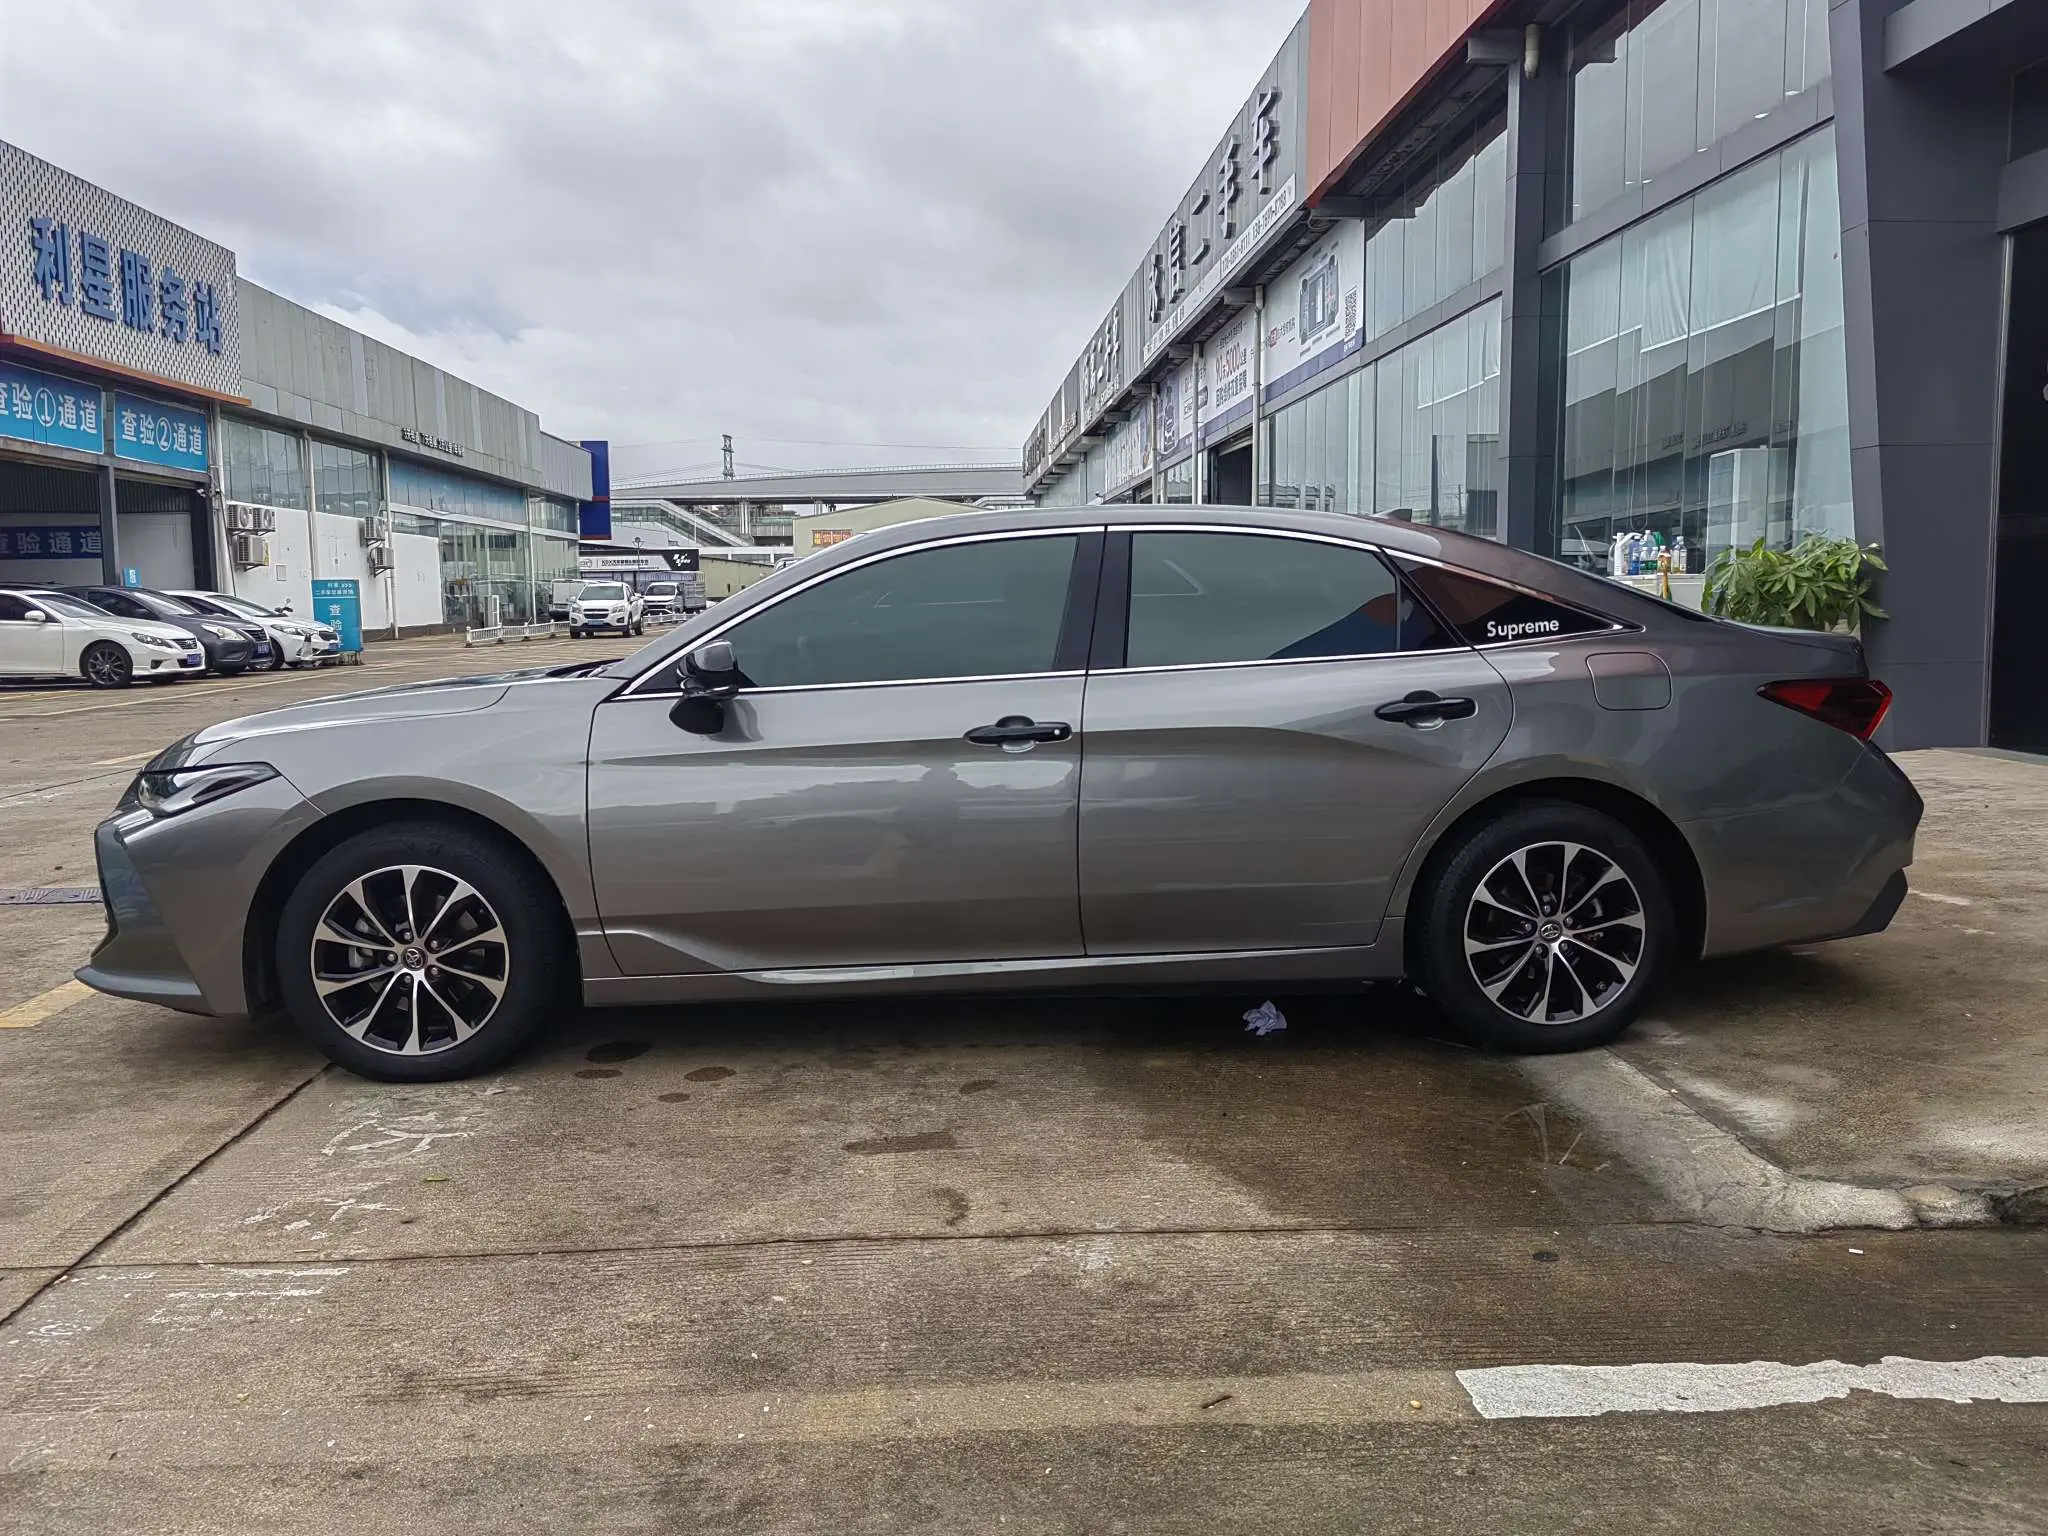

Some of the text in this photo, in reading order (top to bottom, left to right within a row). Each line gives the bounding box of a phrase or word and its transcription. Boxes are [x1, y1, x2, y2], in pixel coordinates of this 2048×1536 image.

[31, 216, 223, 354] 利星服务站
[1486, 619, 1560, 640] Supreme
